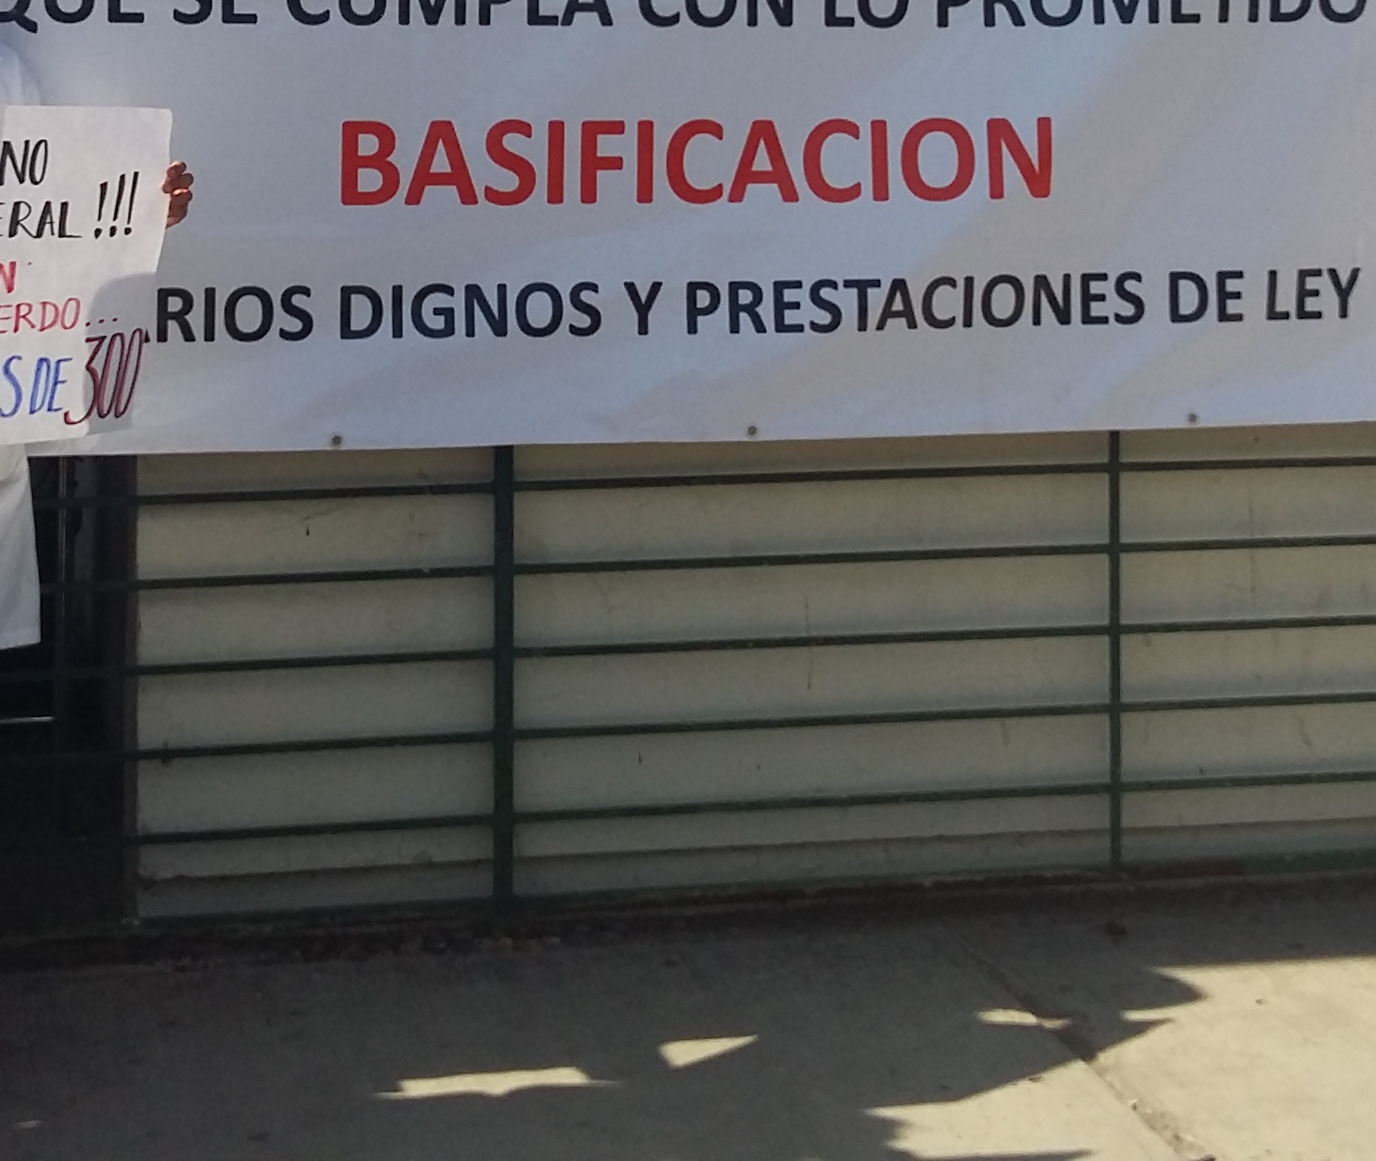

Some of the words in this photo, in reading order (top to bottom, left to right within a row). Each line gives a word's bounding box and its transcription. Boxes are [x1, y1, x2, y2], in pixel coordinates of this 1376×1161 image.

[341, 116, 1052, 206] BASIFICACION
[145, 285, 313, 343] RIOS
[339, 281, 601, 340] DIGNOS
[623, 281, 662, 335] Y
[686, 270, 1144, 335] PRESTACIONES
[1168, 269, 1243, 324] DE
[1265, 267, 1360, 321] LEY
[29, 356, 74, 414] DE
[64, 328, 144, 425] 300
